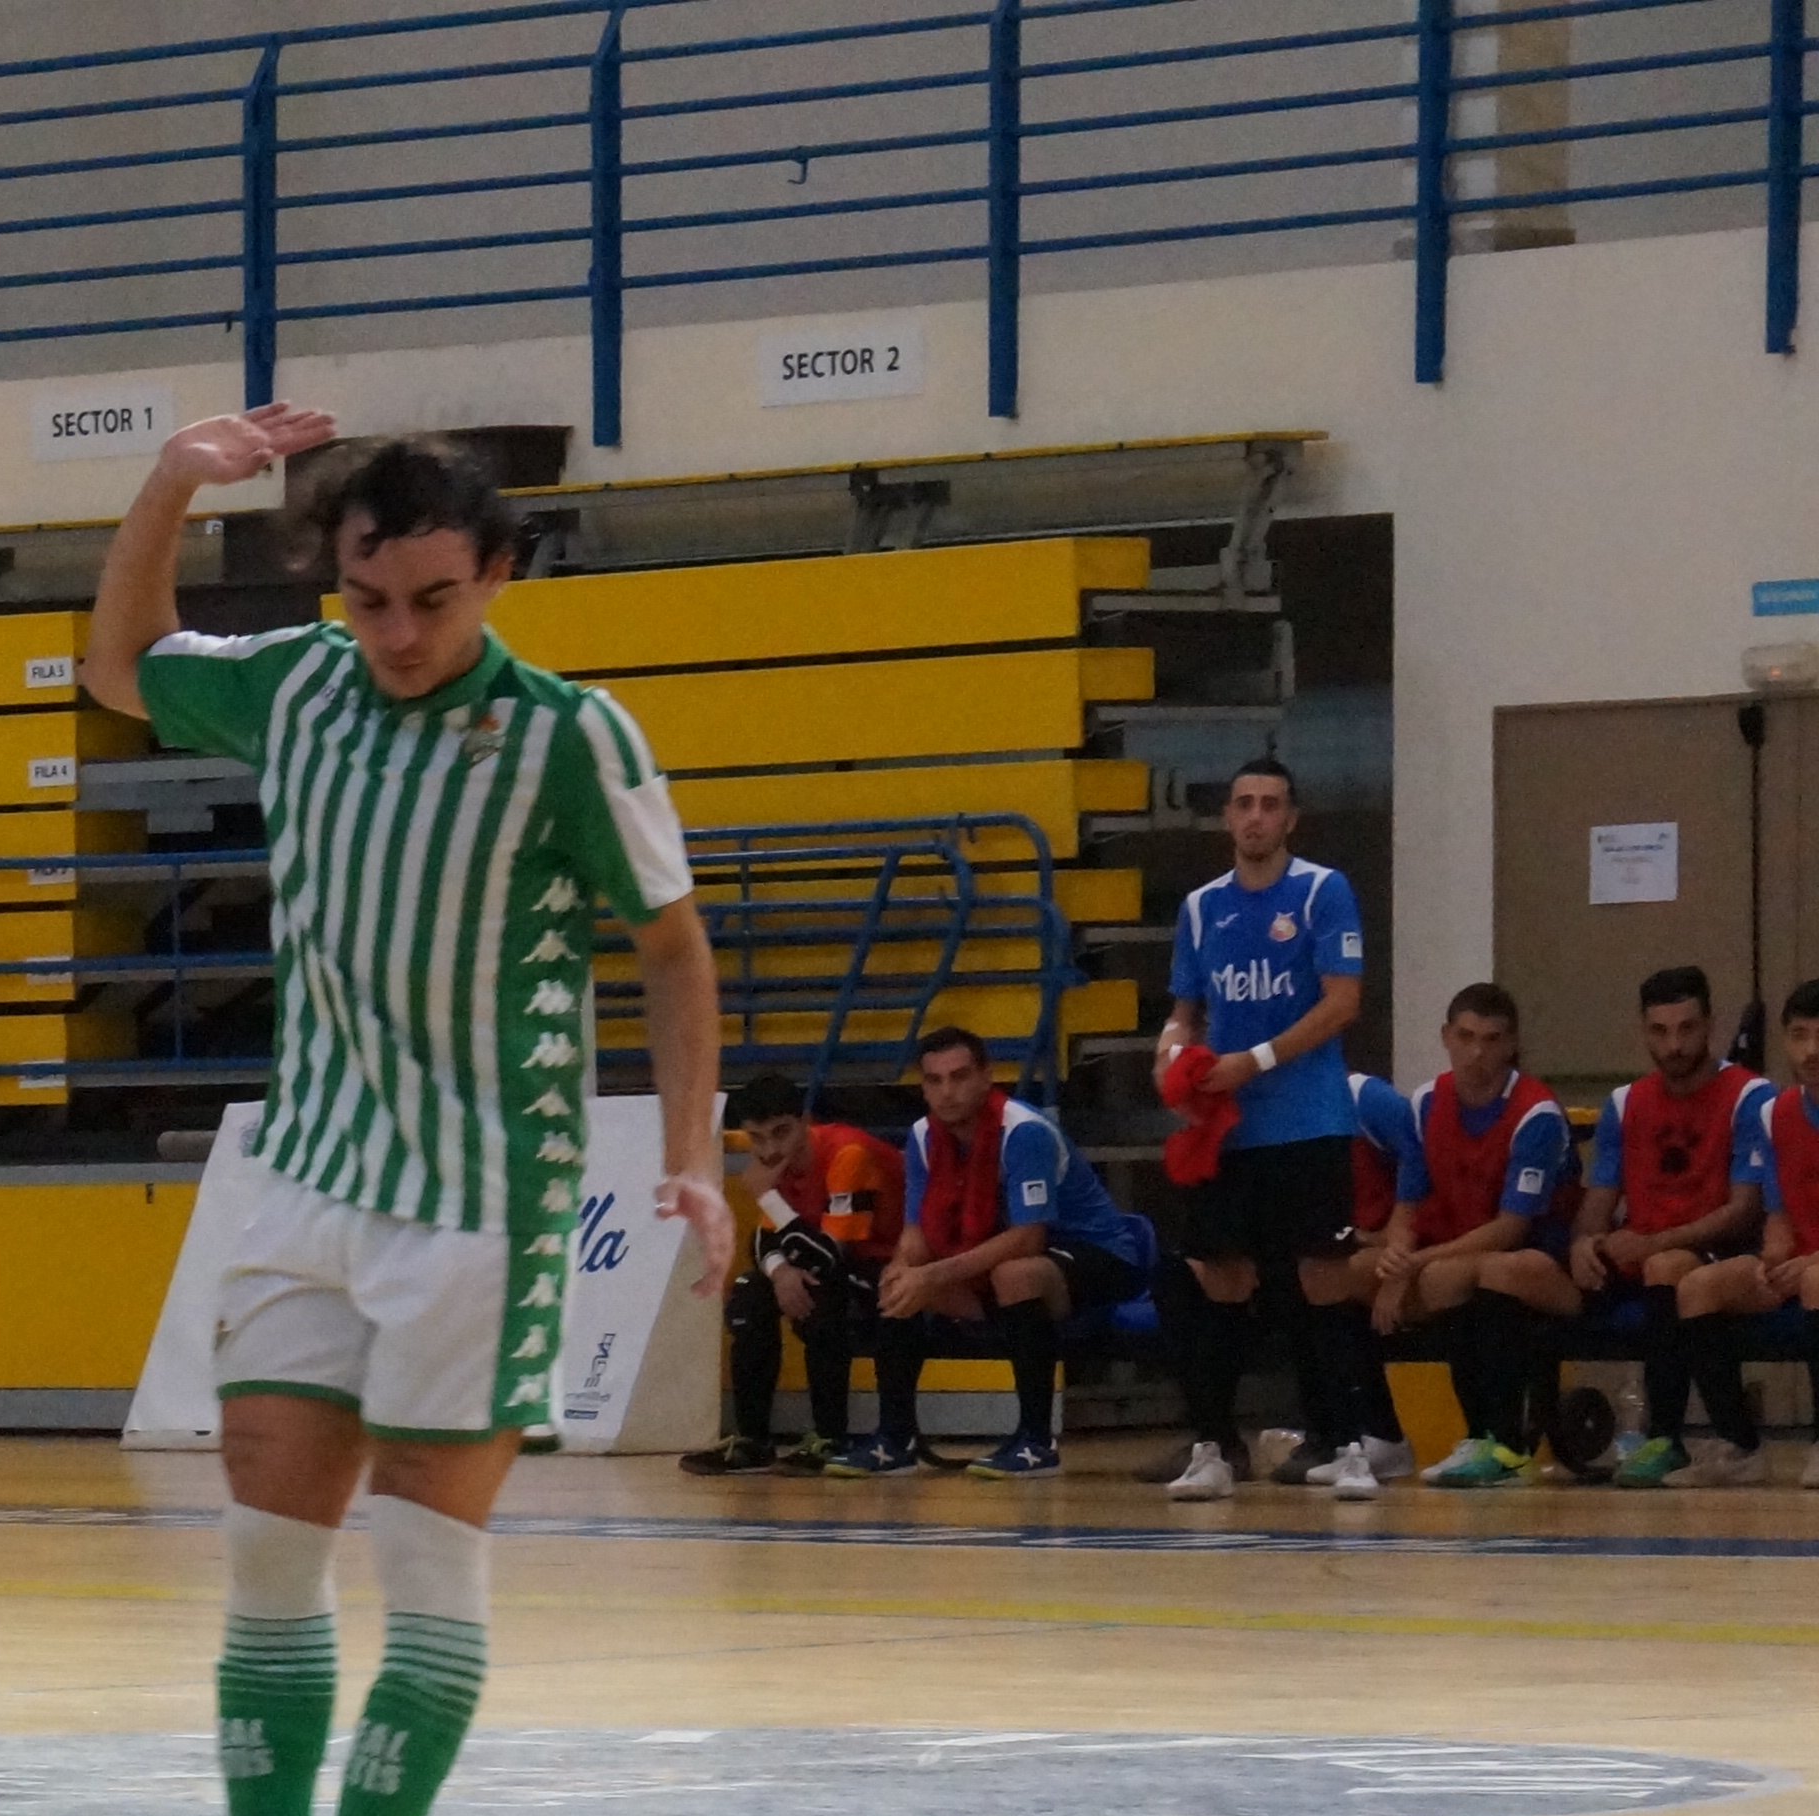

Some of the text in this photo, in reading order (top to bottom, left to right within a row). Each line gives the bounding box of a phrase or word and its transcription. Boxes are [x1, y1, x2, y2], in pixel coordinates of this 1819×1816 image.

[783, 346, 900, 381] SECTOR 2
[52, 406, 153, 438] SECTOR 1
[31, 664, 55, 679] FILA
[34, 765, 58, 778] FILA
